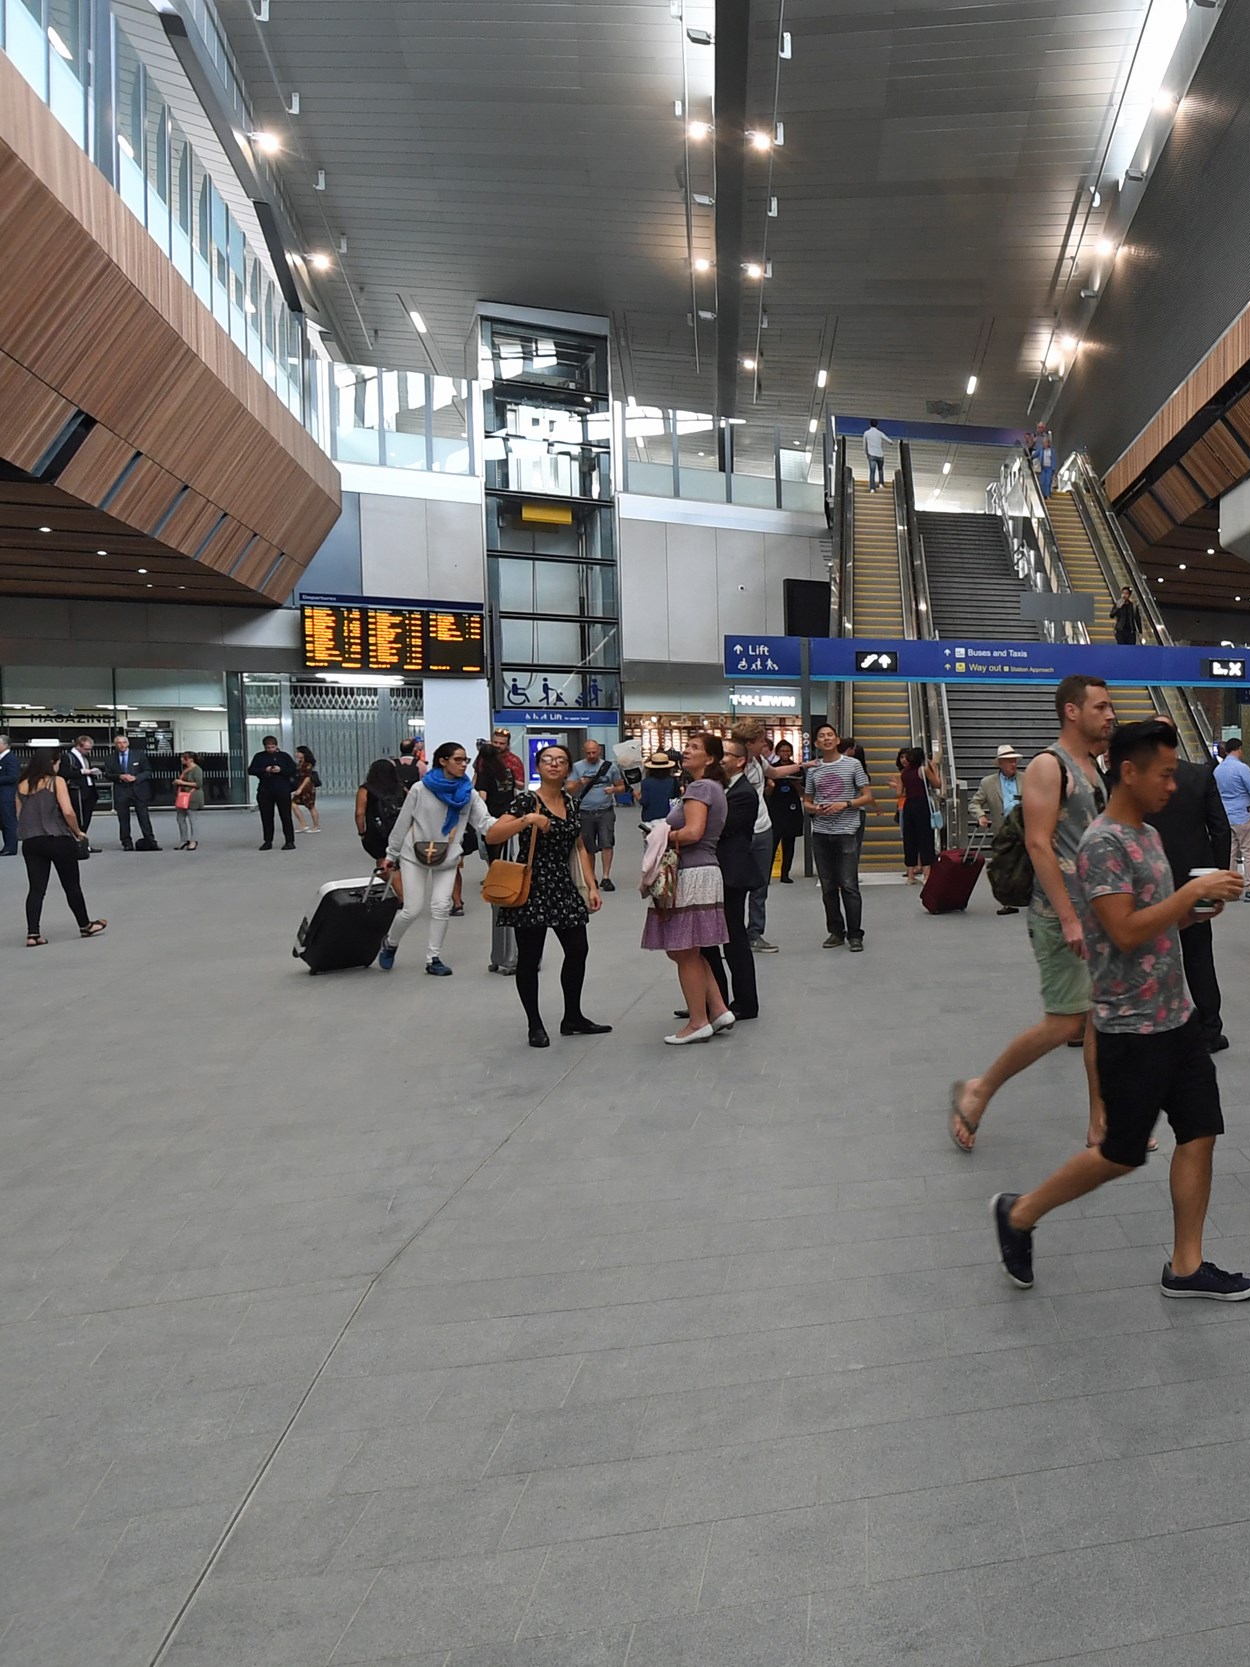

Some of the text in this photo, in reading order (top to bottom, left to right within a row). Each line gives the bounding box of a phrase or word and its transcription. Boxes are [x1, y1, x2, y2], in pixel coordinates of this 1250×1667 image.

[748, 644, 769, 656] Lift
[967, 648, 1028, 657] Buses and Taxis
[969, 663, 987, 673] Way
[989, 663, 1002, 672] out
